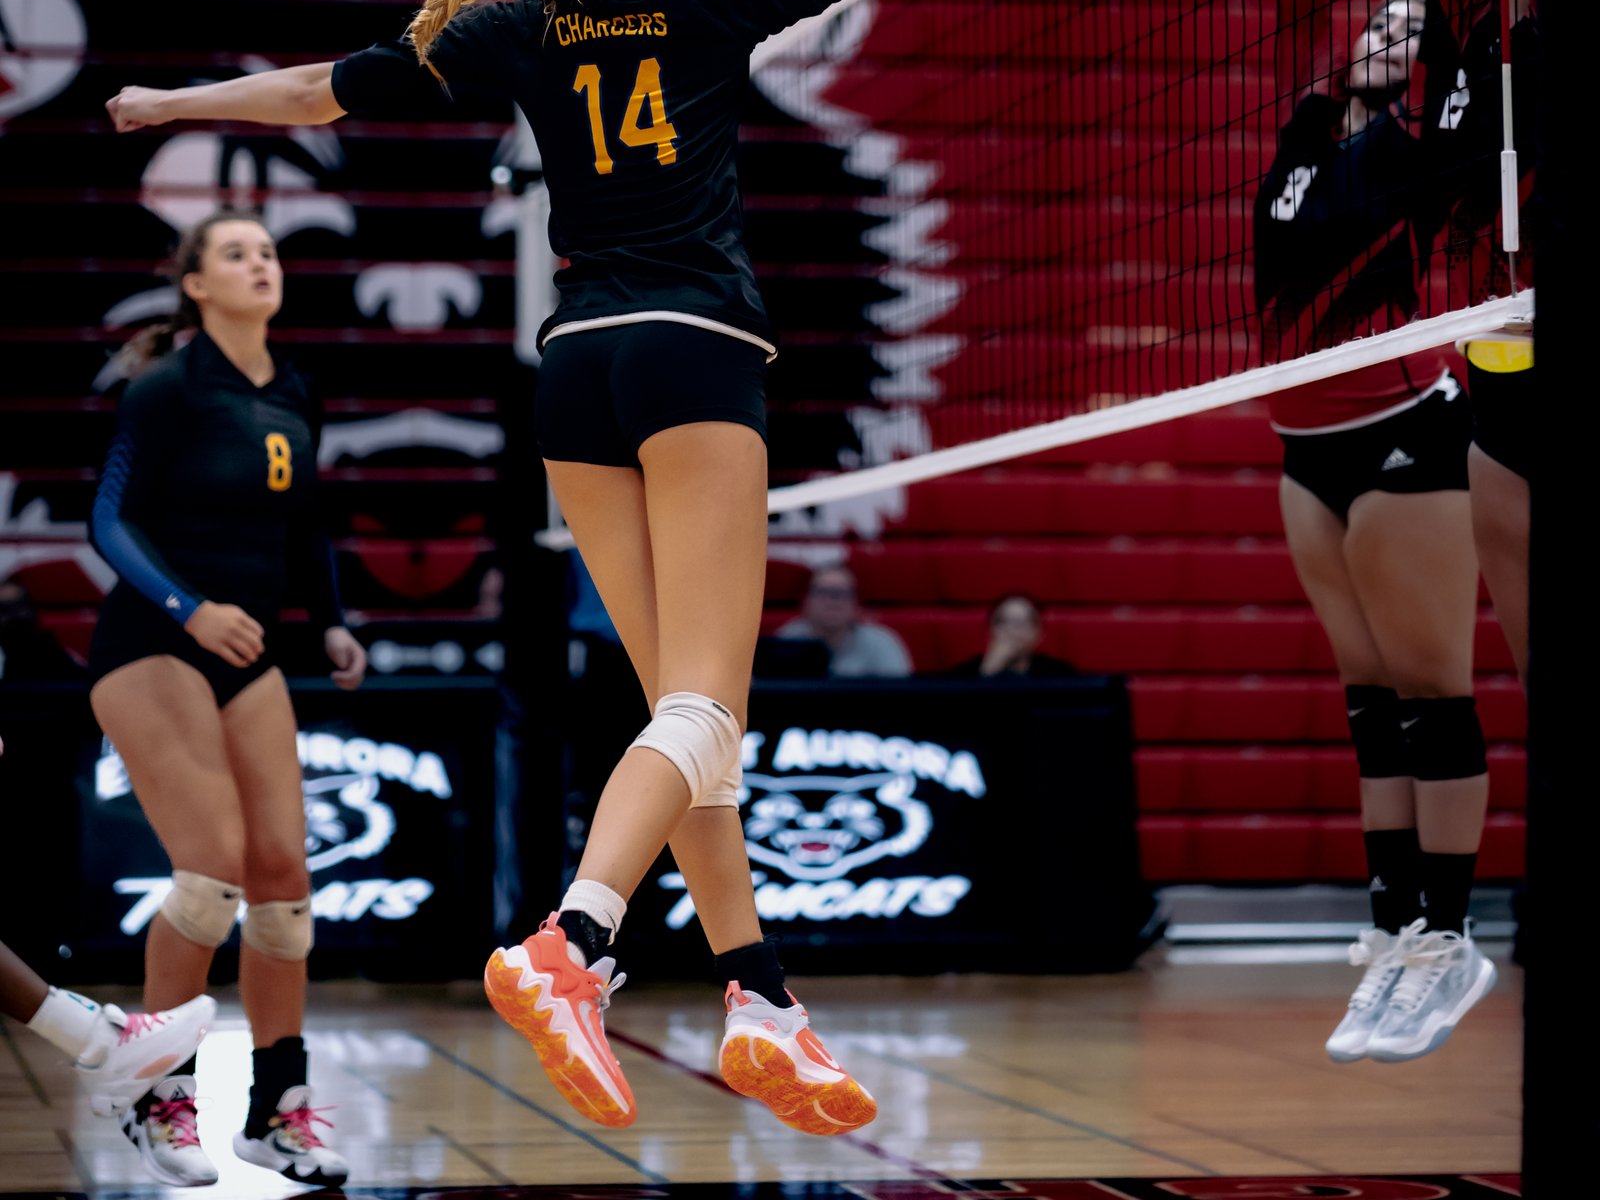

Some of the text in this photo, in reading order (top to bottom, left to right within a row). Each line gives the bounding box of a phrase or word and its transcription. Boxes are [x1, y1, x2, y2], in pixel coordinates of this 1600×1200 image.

[555, 12, 668, 46] CHARGERS
[572, 57, 678, 175] 14
[264, 432, 294, 492] 8
[297, 731, 453, 798] RORA
[772, 728, 986, 798] AURORA
